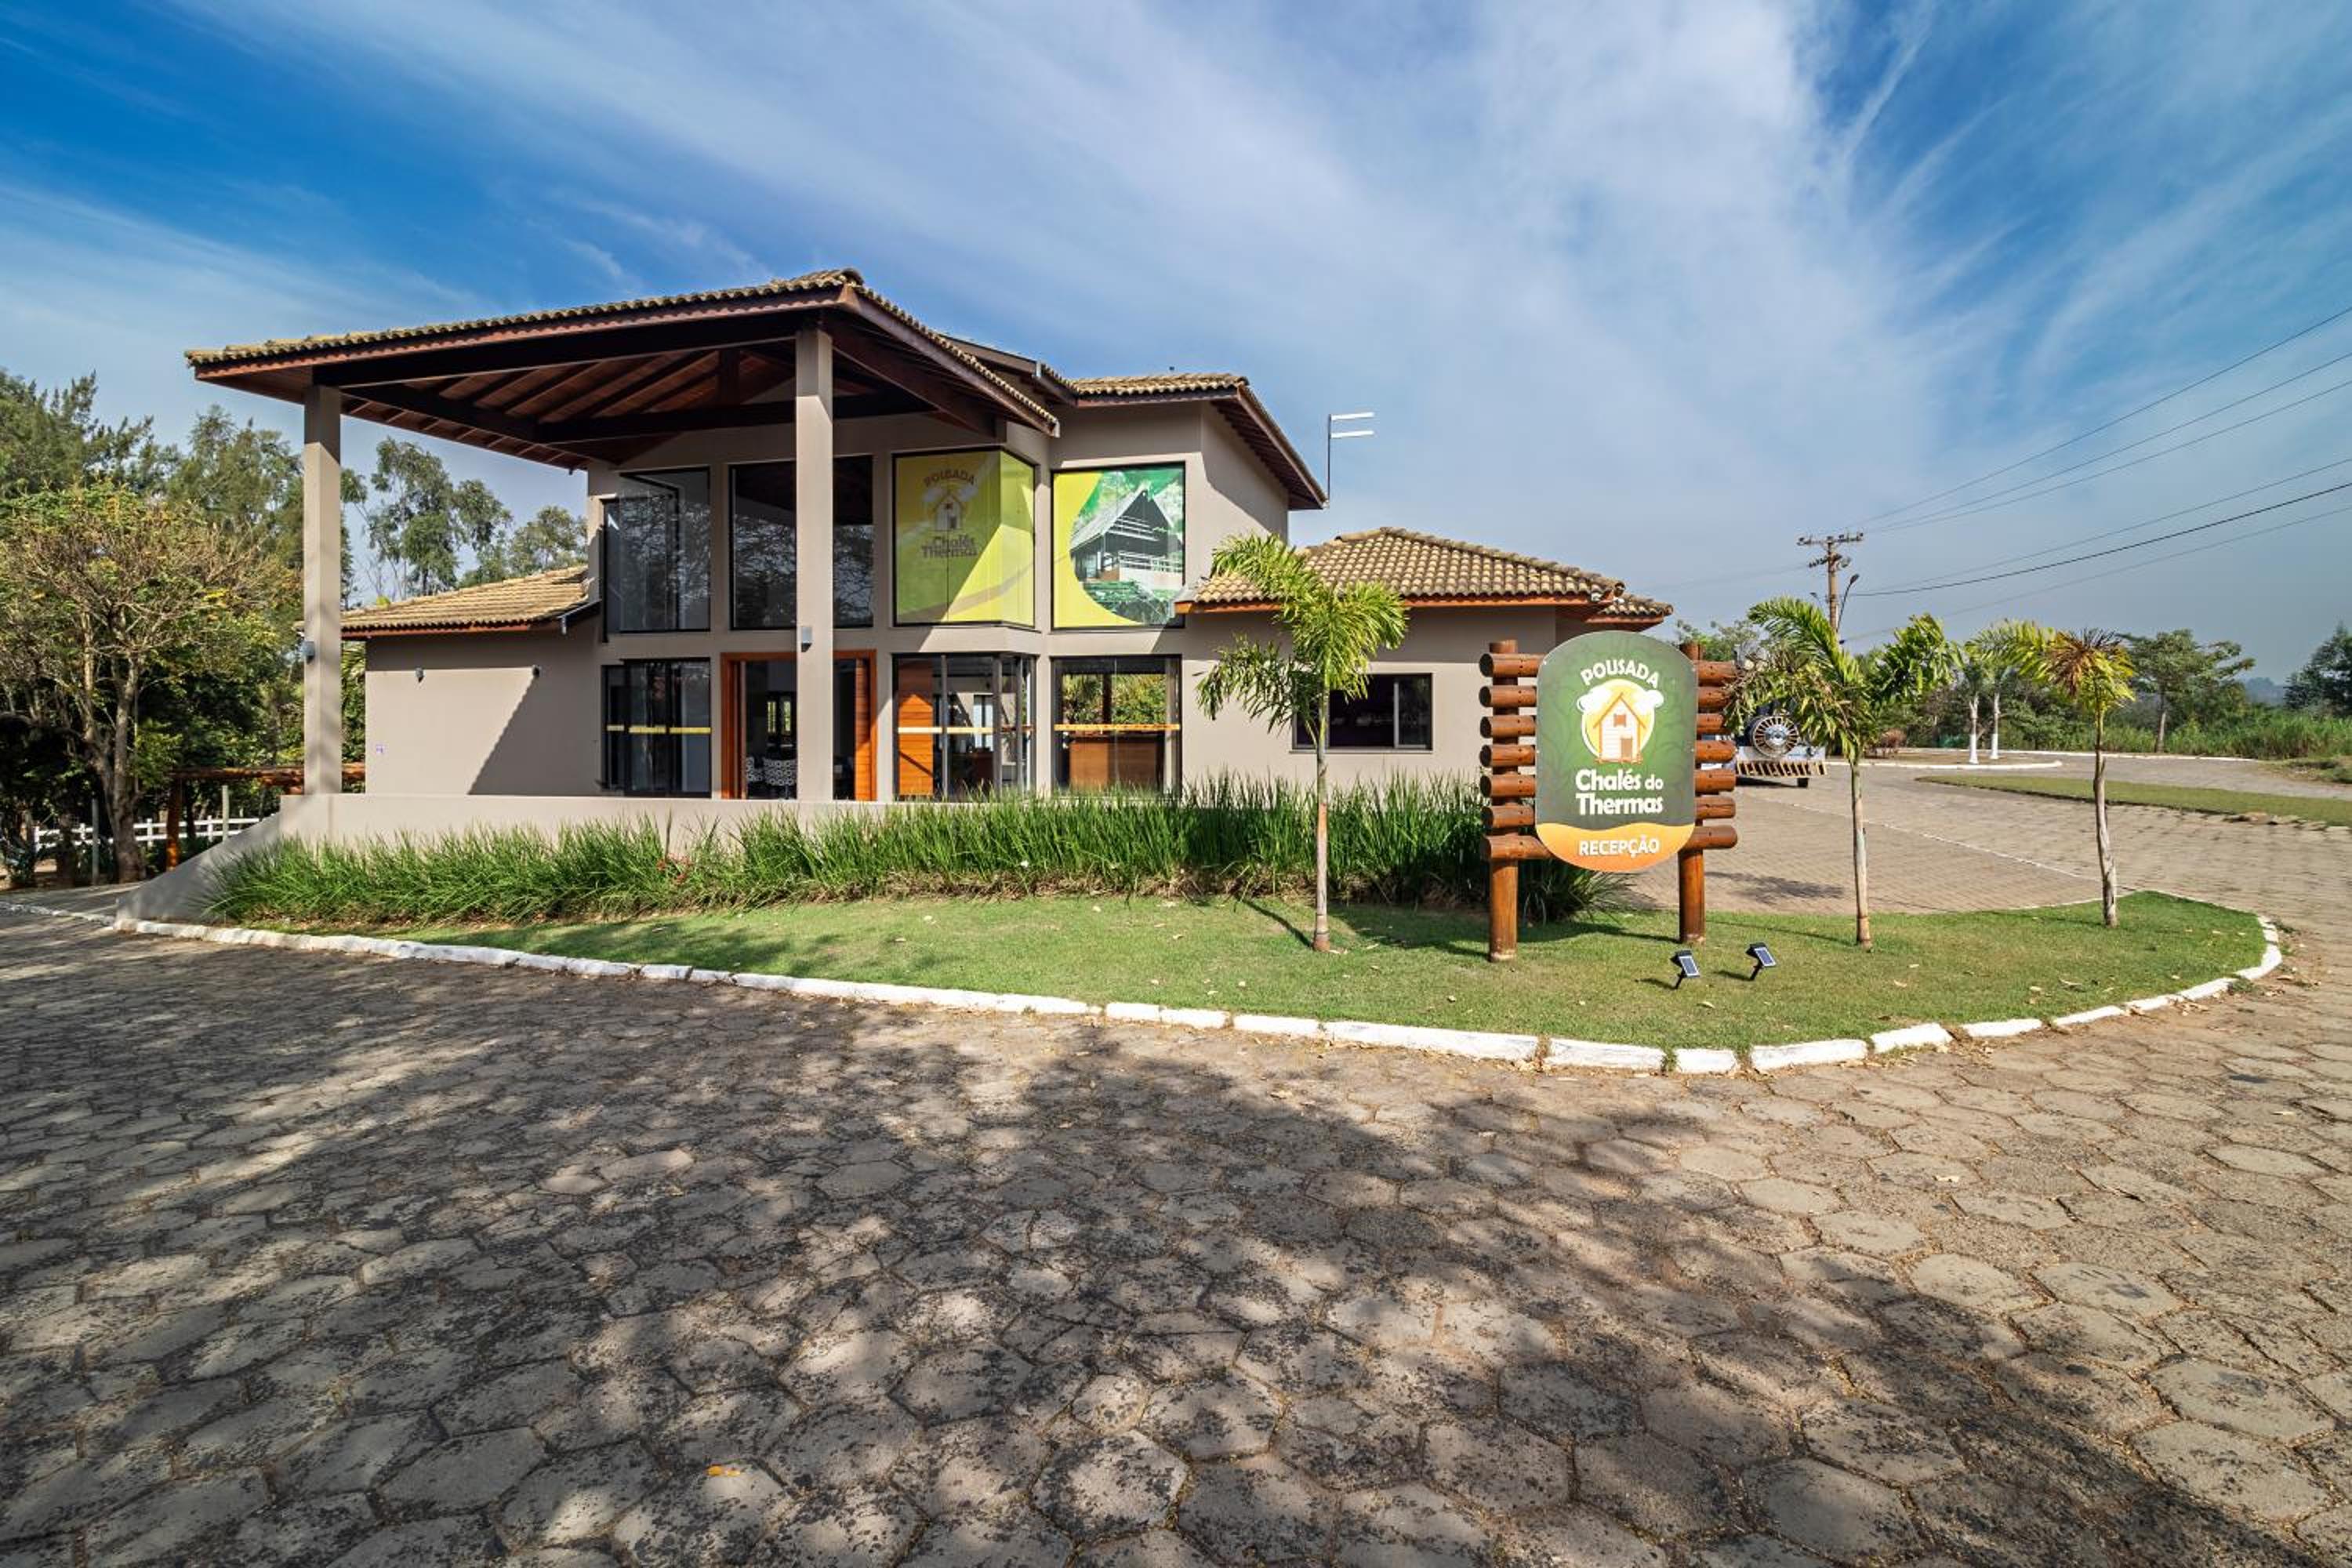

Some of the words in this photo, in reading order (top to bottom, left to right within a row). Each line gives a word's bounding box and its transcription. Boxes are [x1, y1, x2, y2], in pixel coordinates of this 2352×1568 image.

[1580, 659, 1660, 689] POUSADA
[1575, 768, 1641, 791] Chalés
[1645, 775, 1664, 790] do
[1576, 793, 1664, 815] Thermas
[1579, 836, 1661, 858] RECEPÇÃO
